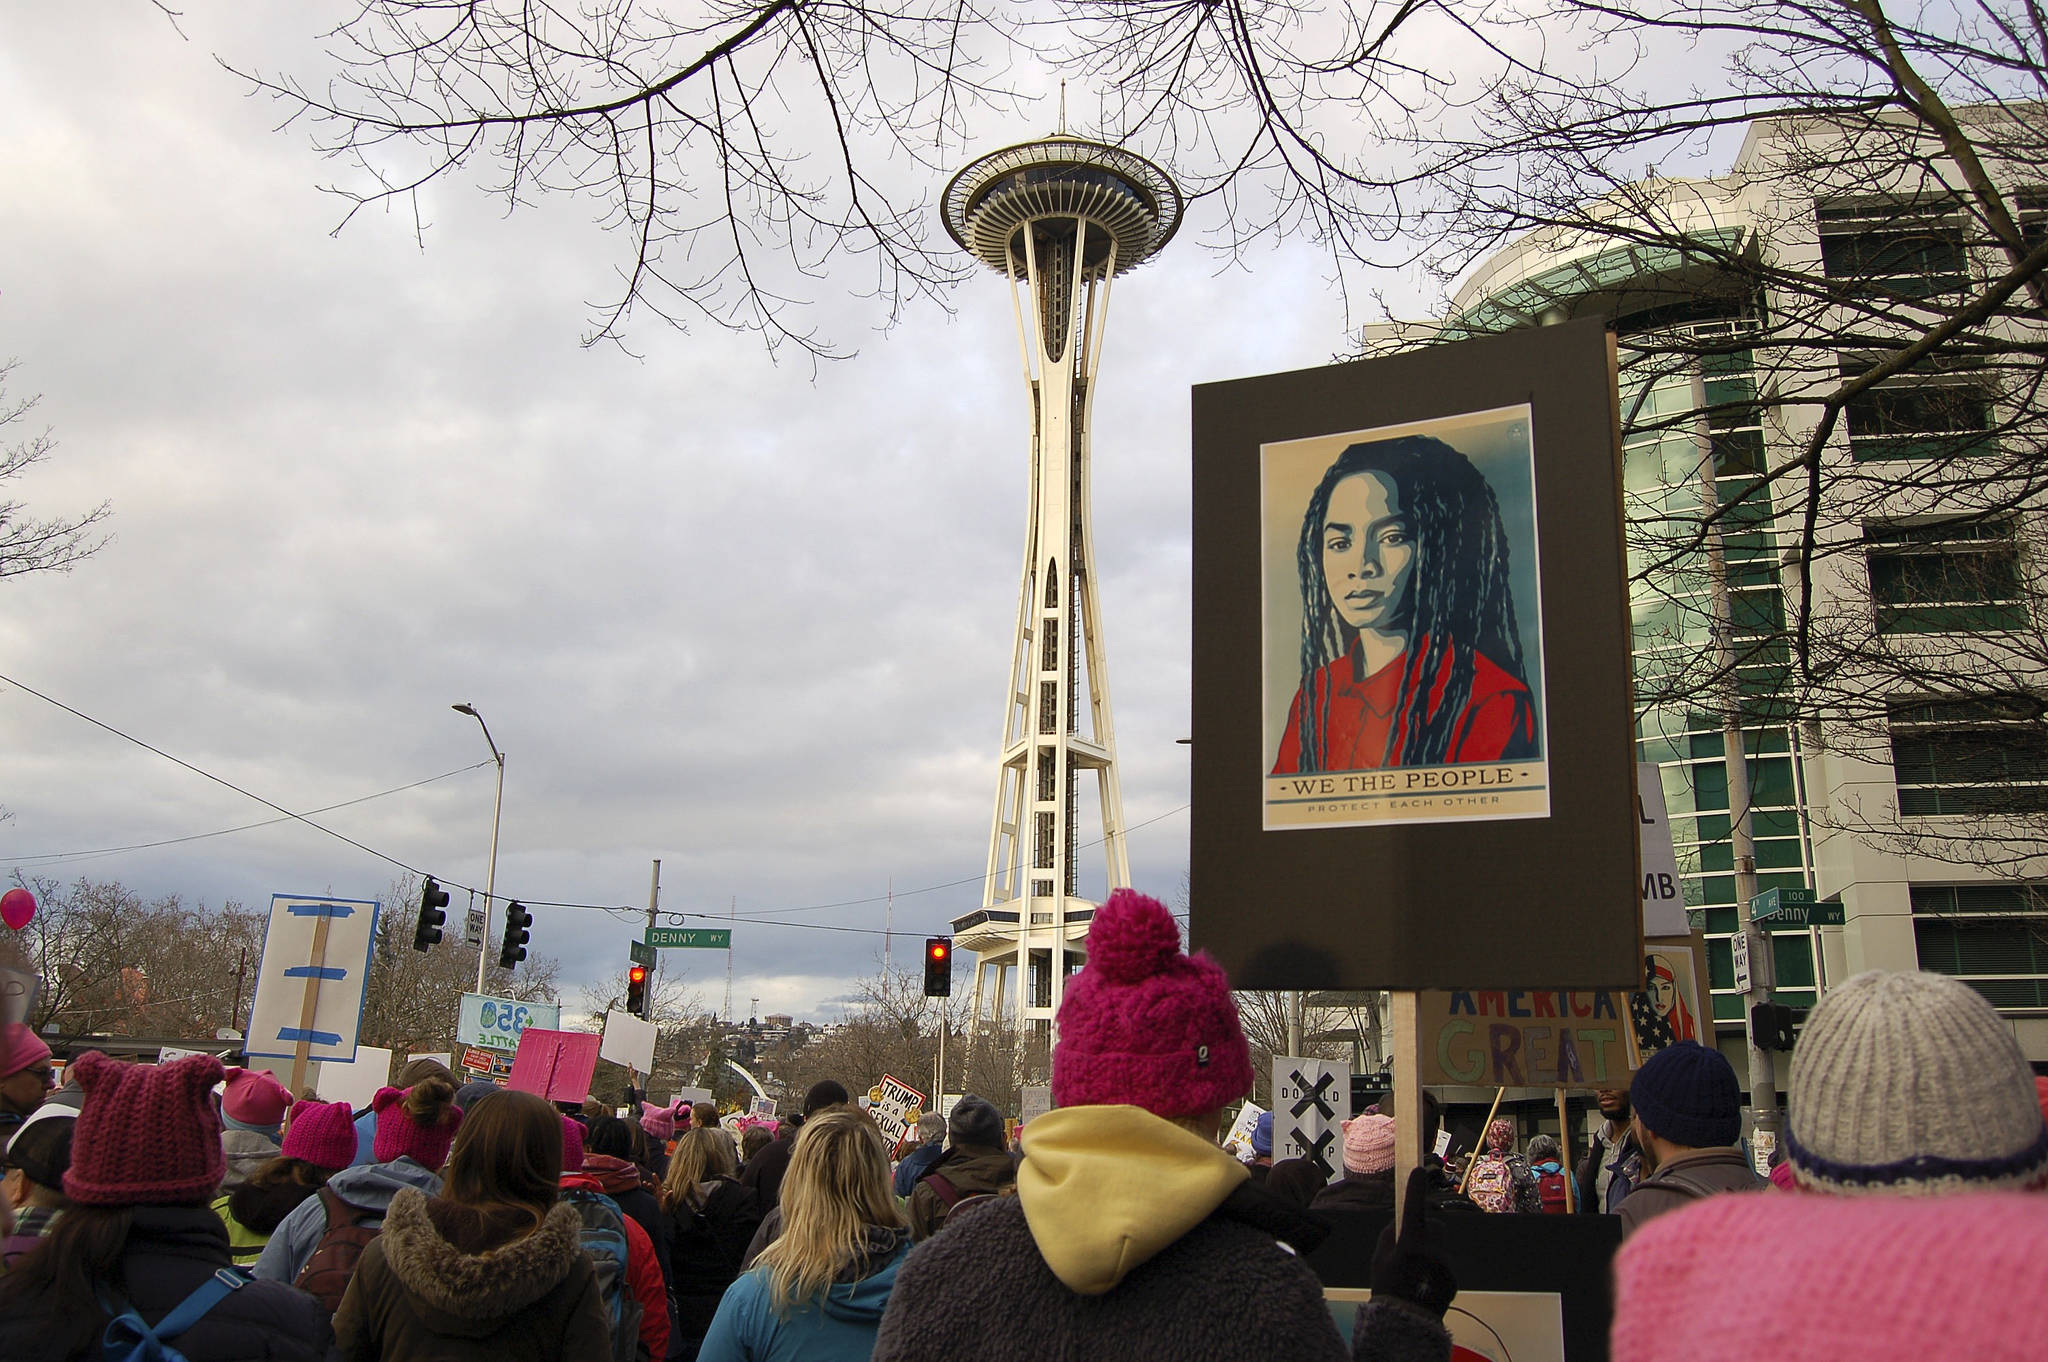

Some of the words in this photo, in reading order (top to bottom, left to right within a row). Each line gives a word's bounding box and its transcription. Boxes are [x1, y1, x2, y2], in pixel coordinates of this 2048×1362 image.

[1292, 778, 1336, 795] WE
[1343, 773, 1396, 792] THE
[1405, 768, 1515, 789] PEOPLE
[1307, 801, 1380, 813] PROTECT
[1390, 799, 1433, 809] EACH
[1443, 795, 1500, 807] OTHER
[1768, 896, 1777, 908] AVE
[1788, 891, 1805, 901] 100
[470, 913, 484, 925] ONE
[1827, 912, 1841, 921] WY
[470, 923, 484, 935] WAY
[651, 932, 696, 944] DENNY
[710, 934, 724, 943] WY
[1732, 935, 1746, 952] ONE
[1734, 952, 1747, 969] WAY
[1448, 991, 1618, 1020] AMERICA
[1437, 1018, 1617, 1084] GREAT
[882, 1081, 919, 1110] TRUMP
[1281, 1087, 1340, 1102] DOLD
[1284, 1143, 1335, 1158] TRP
